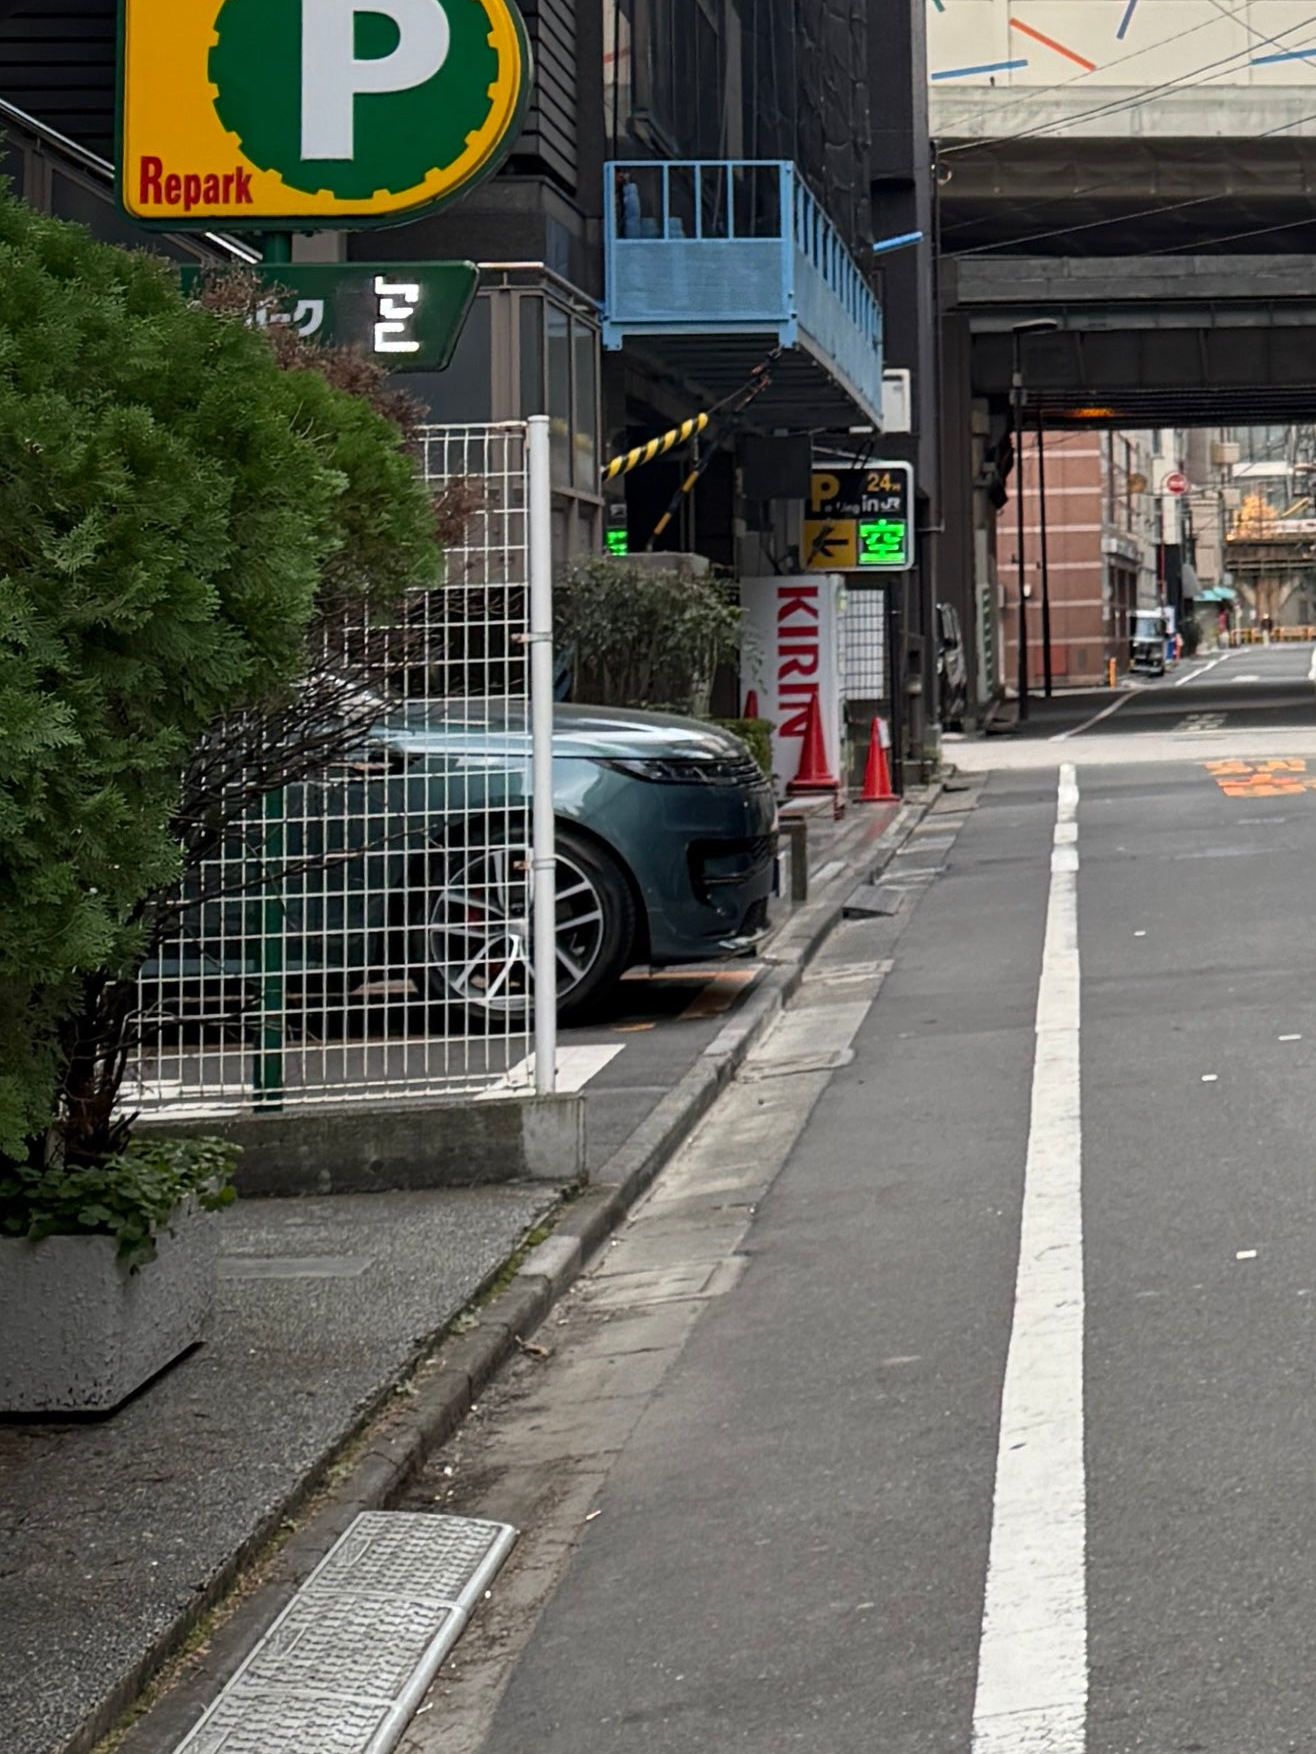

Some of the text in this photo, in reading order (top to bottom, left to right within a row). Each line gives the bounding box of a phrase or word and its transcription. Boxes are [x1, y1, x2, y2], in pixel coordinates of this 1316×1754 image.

[139, 155, 254, 212] Repark
[859, 517, 906, 563] 空
[777, 585, 820, 739] KIRIN
